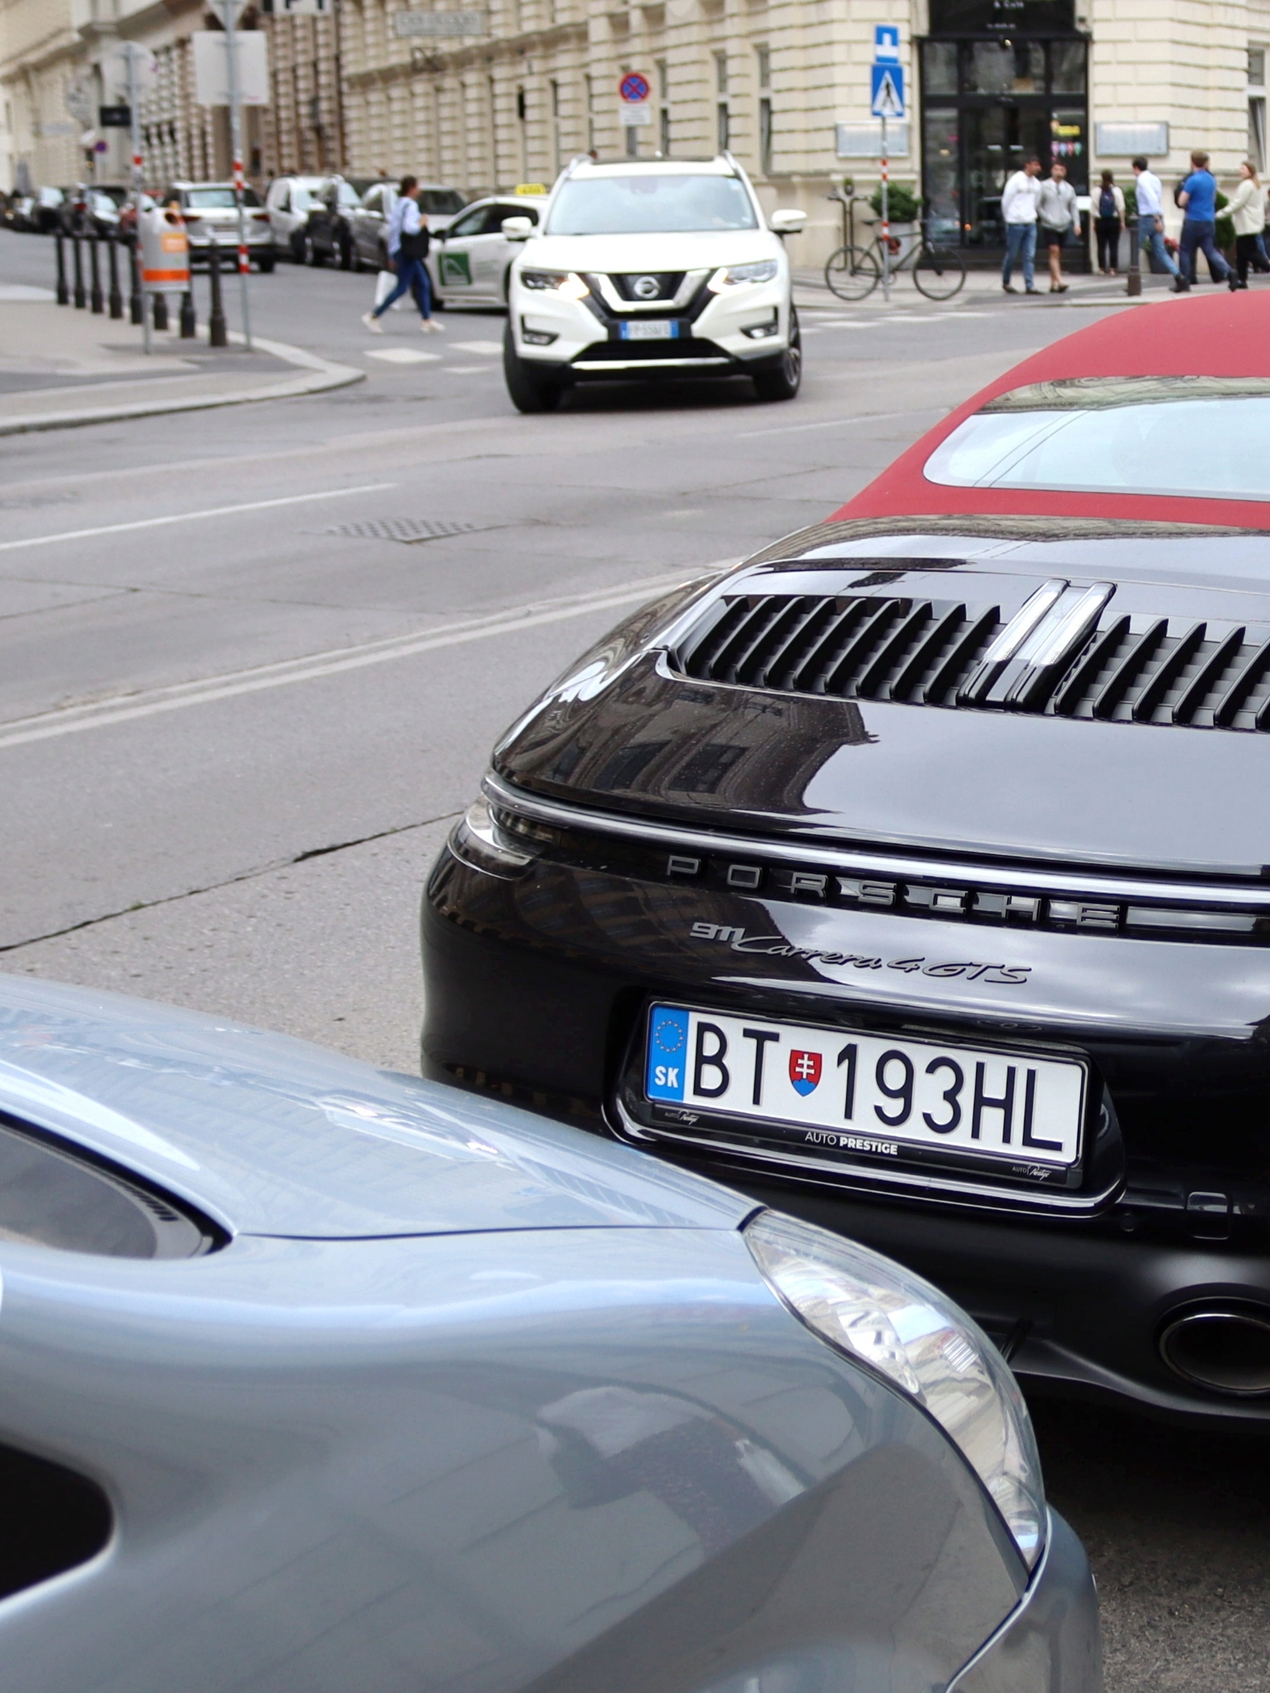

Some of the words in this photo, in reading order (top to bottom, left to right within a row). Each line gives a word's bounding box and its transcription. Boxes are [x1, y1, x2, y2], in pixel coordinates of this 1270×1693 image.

[667, 855, 1120, 928] PORSCHE
[690, 921, 745, 941] 911
[731, 936, 882, 970] Carrera
[887, 957, 925, 973] 4
[922, 961, 1032, 985] GTS
[654, 1065, 680, 1089] SK
[692, 1020, 780, 1107] BT
[836, 1043, 1064, 1152] 193HL
[804, 1131, 837, 1146] AUTO
[839, 1136, 898, 1156] PRESTIGE
